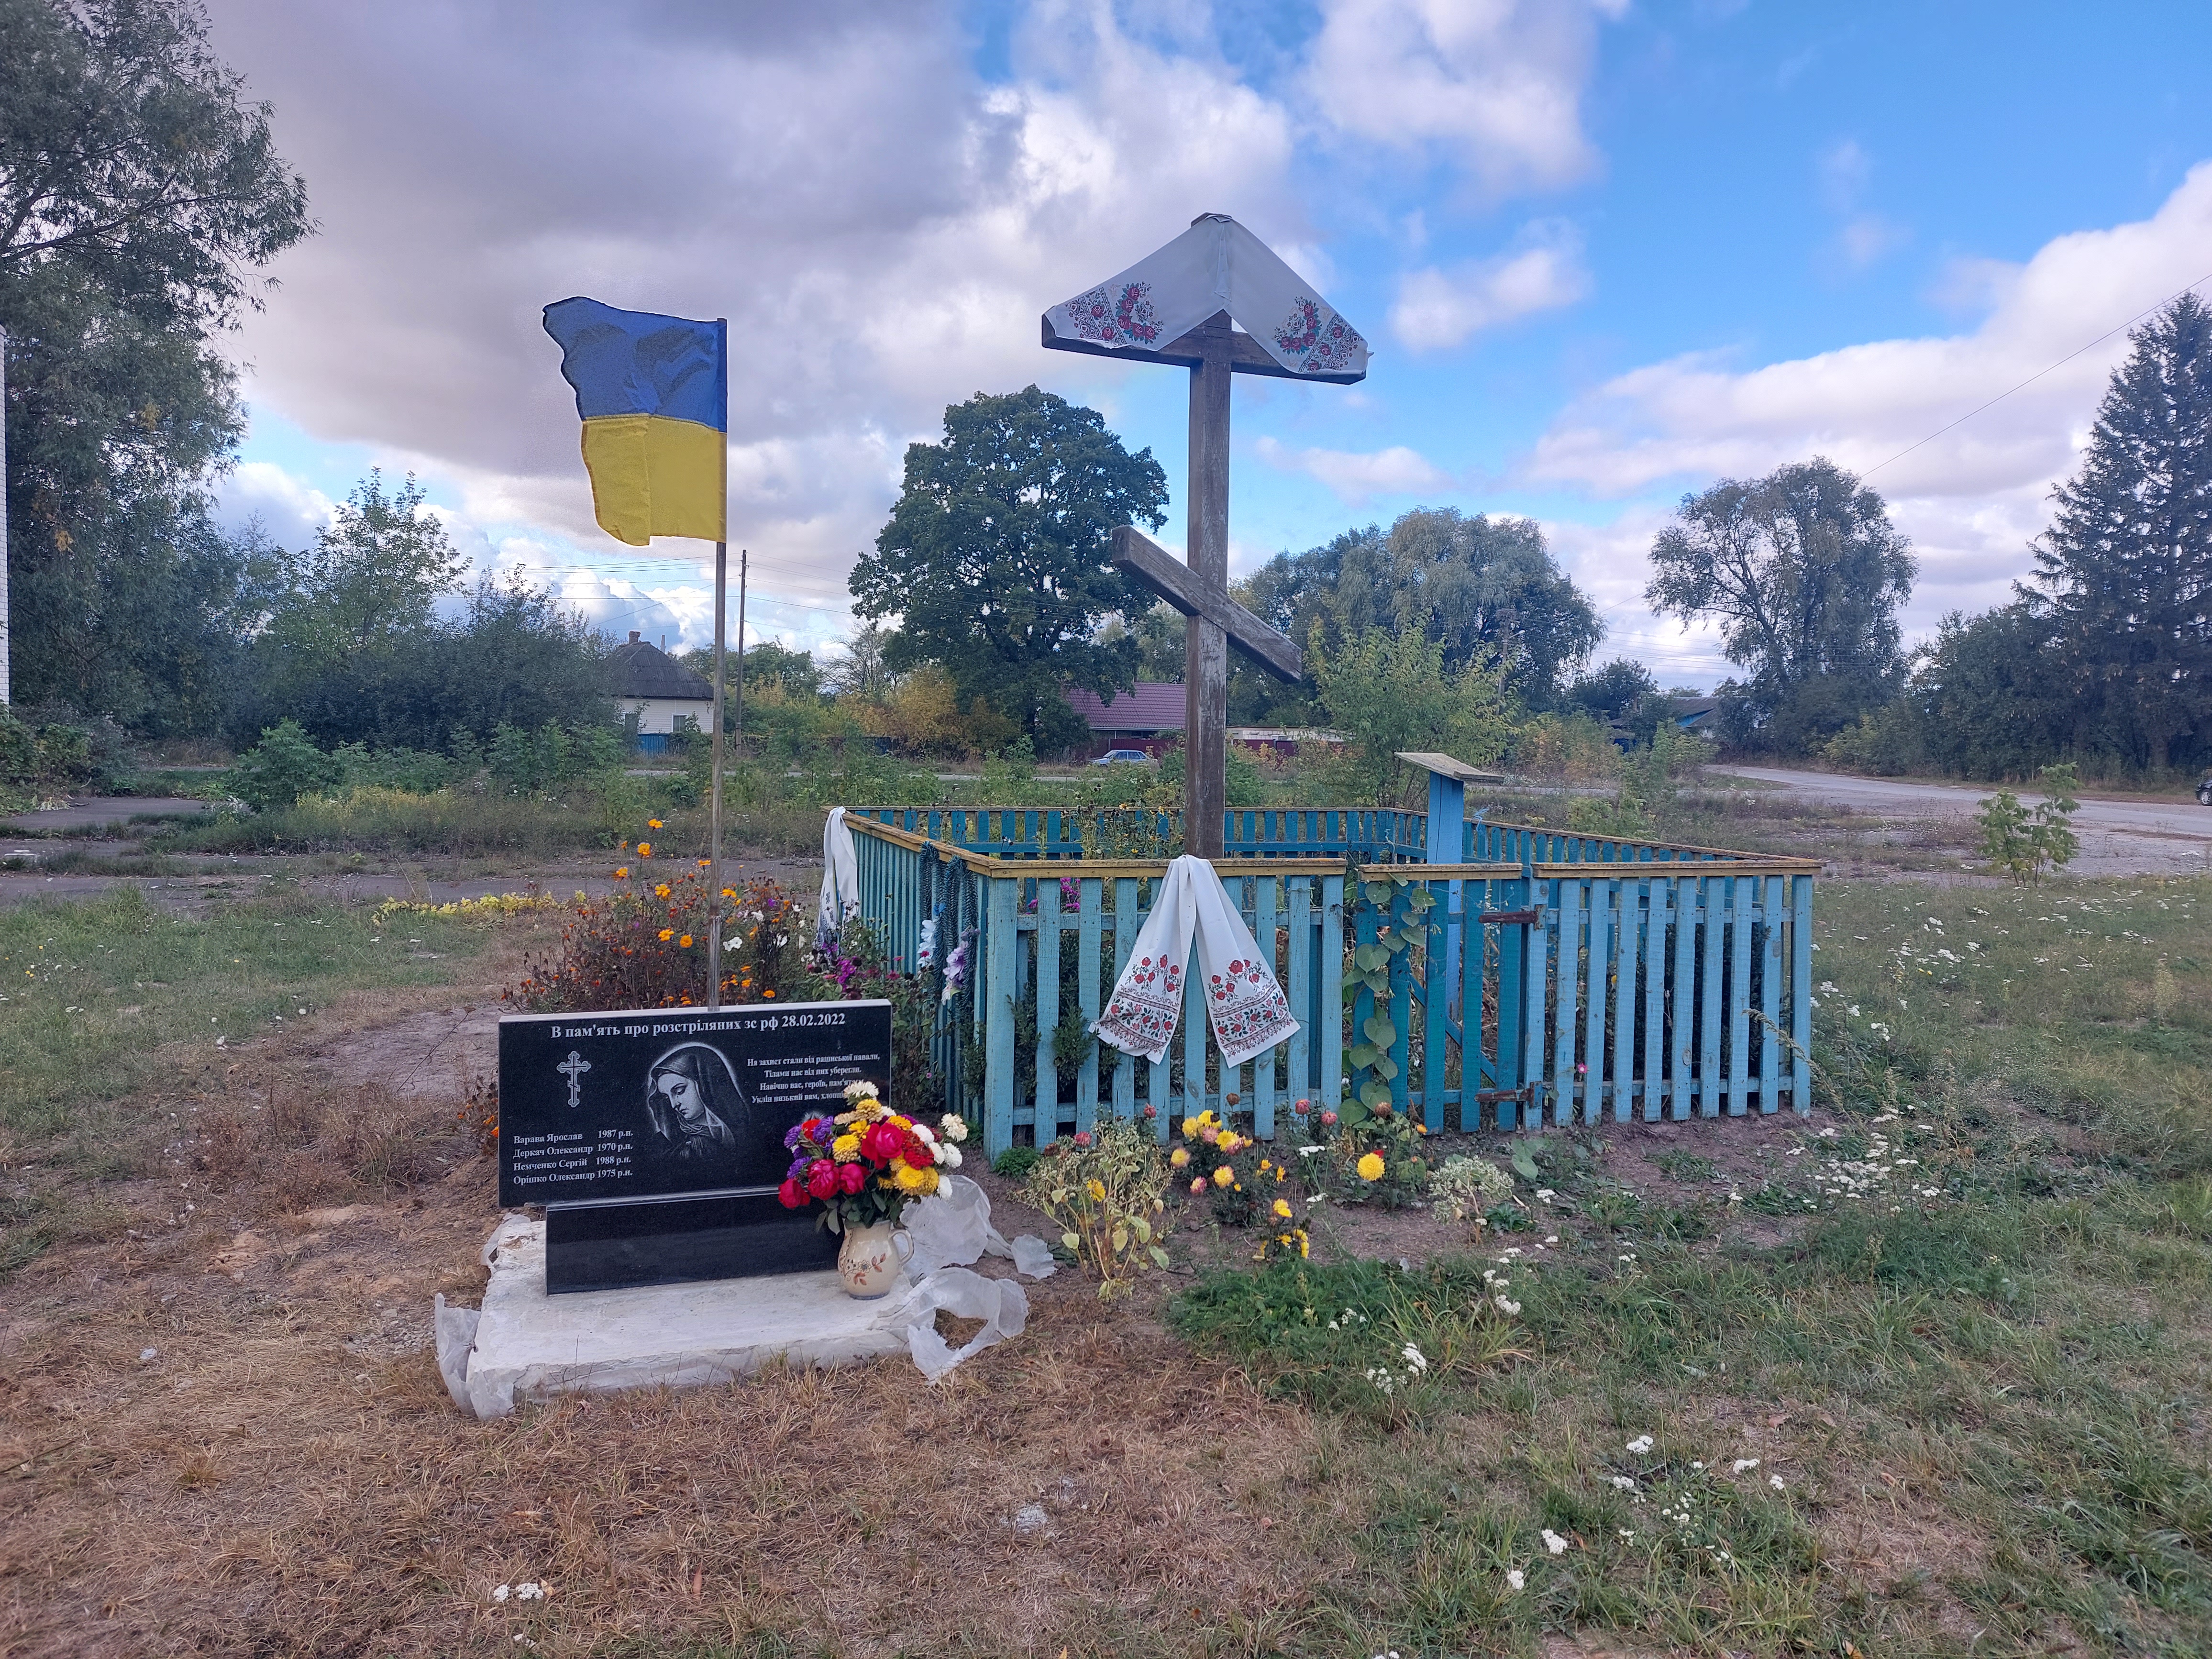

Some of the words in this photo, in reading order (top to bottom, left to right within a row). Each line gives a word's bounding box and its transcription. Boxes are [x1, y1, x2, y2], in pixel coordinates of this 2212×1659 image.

[550, 1026, 561, 1038] В
[565, 1024, 620, 1037] пам'ять
[624, 1025, 649, 1037] про
[652, 1019, 741, 1037] розстріляних
[760, 1017, 778, 1031] рф
[782, 1013, 846, 1028] 28.02.2022
[747, 1058, 758, 1066] На
[804, 1055, 815, 1063] від
[764, 1070, 789, 1078] Тілами
[804, 1067, 815, 1076] від
[830, 1066, 862, 1076] уберегли.
[760, 1082, 789, 1091] Навічно
[805, 1080, 828, 1089] героїв,
[751, 1095, 772, 1103] Уклін
[774, 1093, 803, 1102] низький
[513, 1136, 545, 1145] Варава
[546, 1133, 583, 1143] Ярослав
[598, 1129, 617, 1138] 1987
[618, 1129, 633, 1139] р.н.
[513, 1149, 545, 1159] Деркач
[547, 1146, 593, 1155] Олександр
[597, 1142, 616, 1151] 1970
[618, 1143, 633, 1152] р.н.
[513, 1161, 557, 1171] Немченко
[559, 1158, 587, 1168] Сергій
[596, 1156, 615, 1165] 1988
[616, 1157, 631, 1165] р.н.
[513, 1175, 547, 1185] Орішко
[549, 1172, 595, 1182] Олександр
[597, 1169, 616, 1178] 1975
[618, 1169, 633, 1179] р.н.
